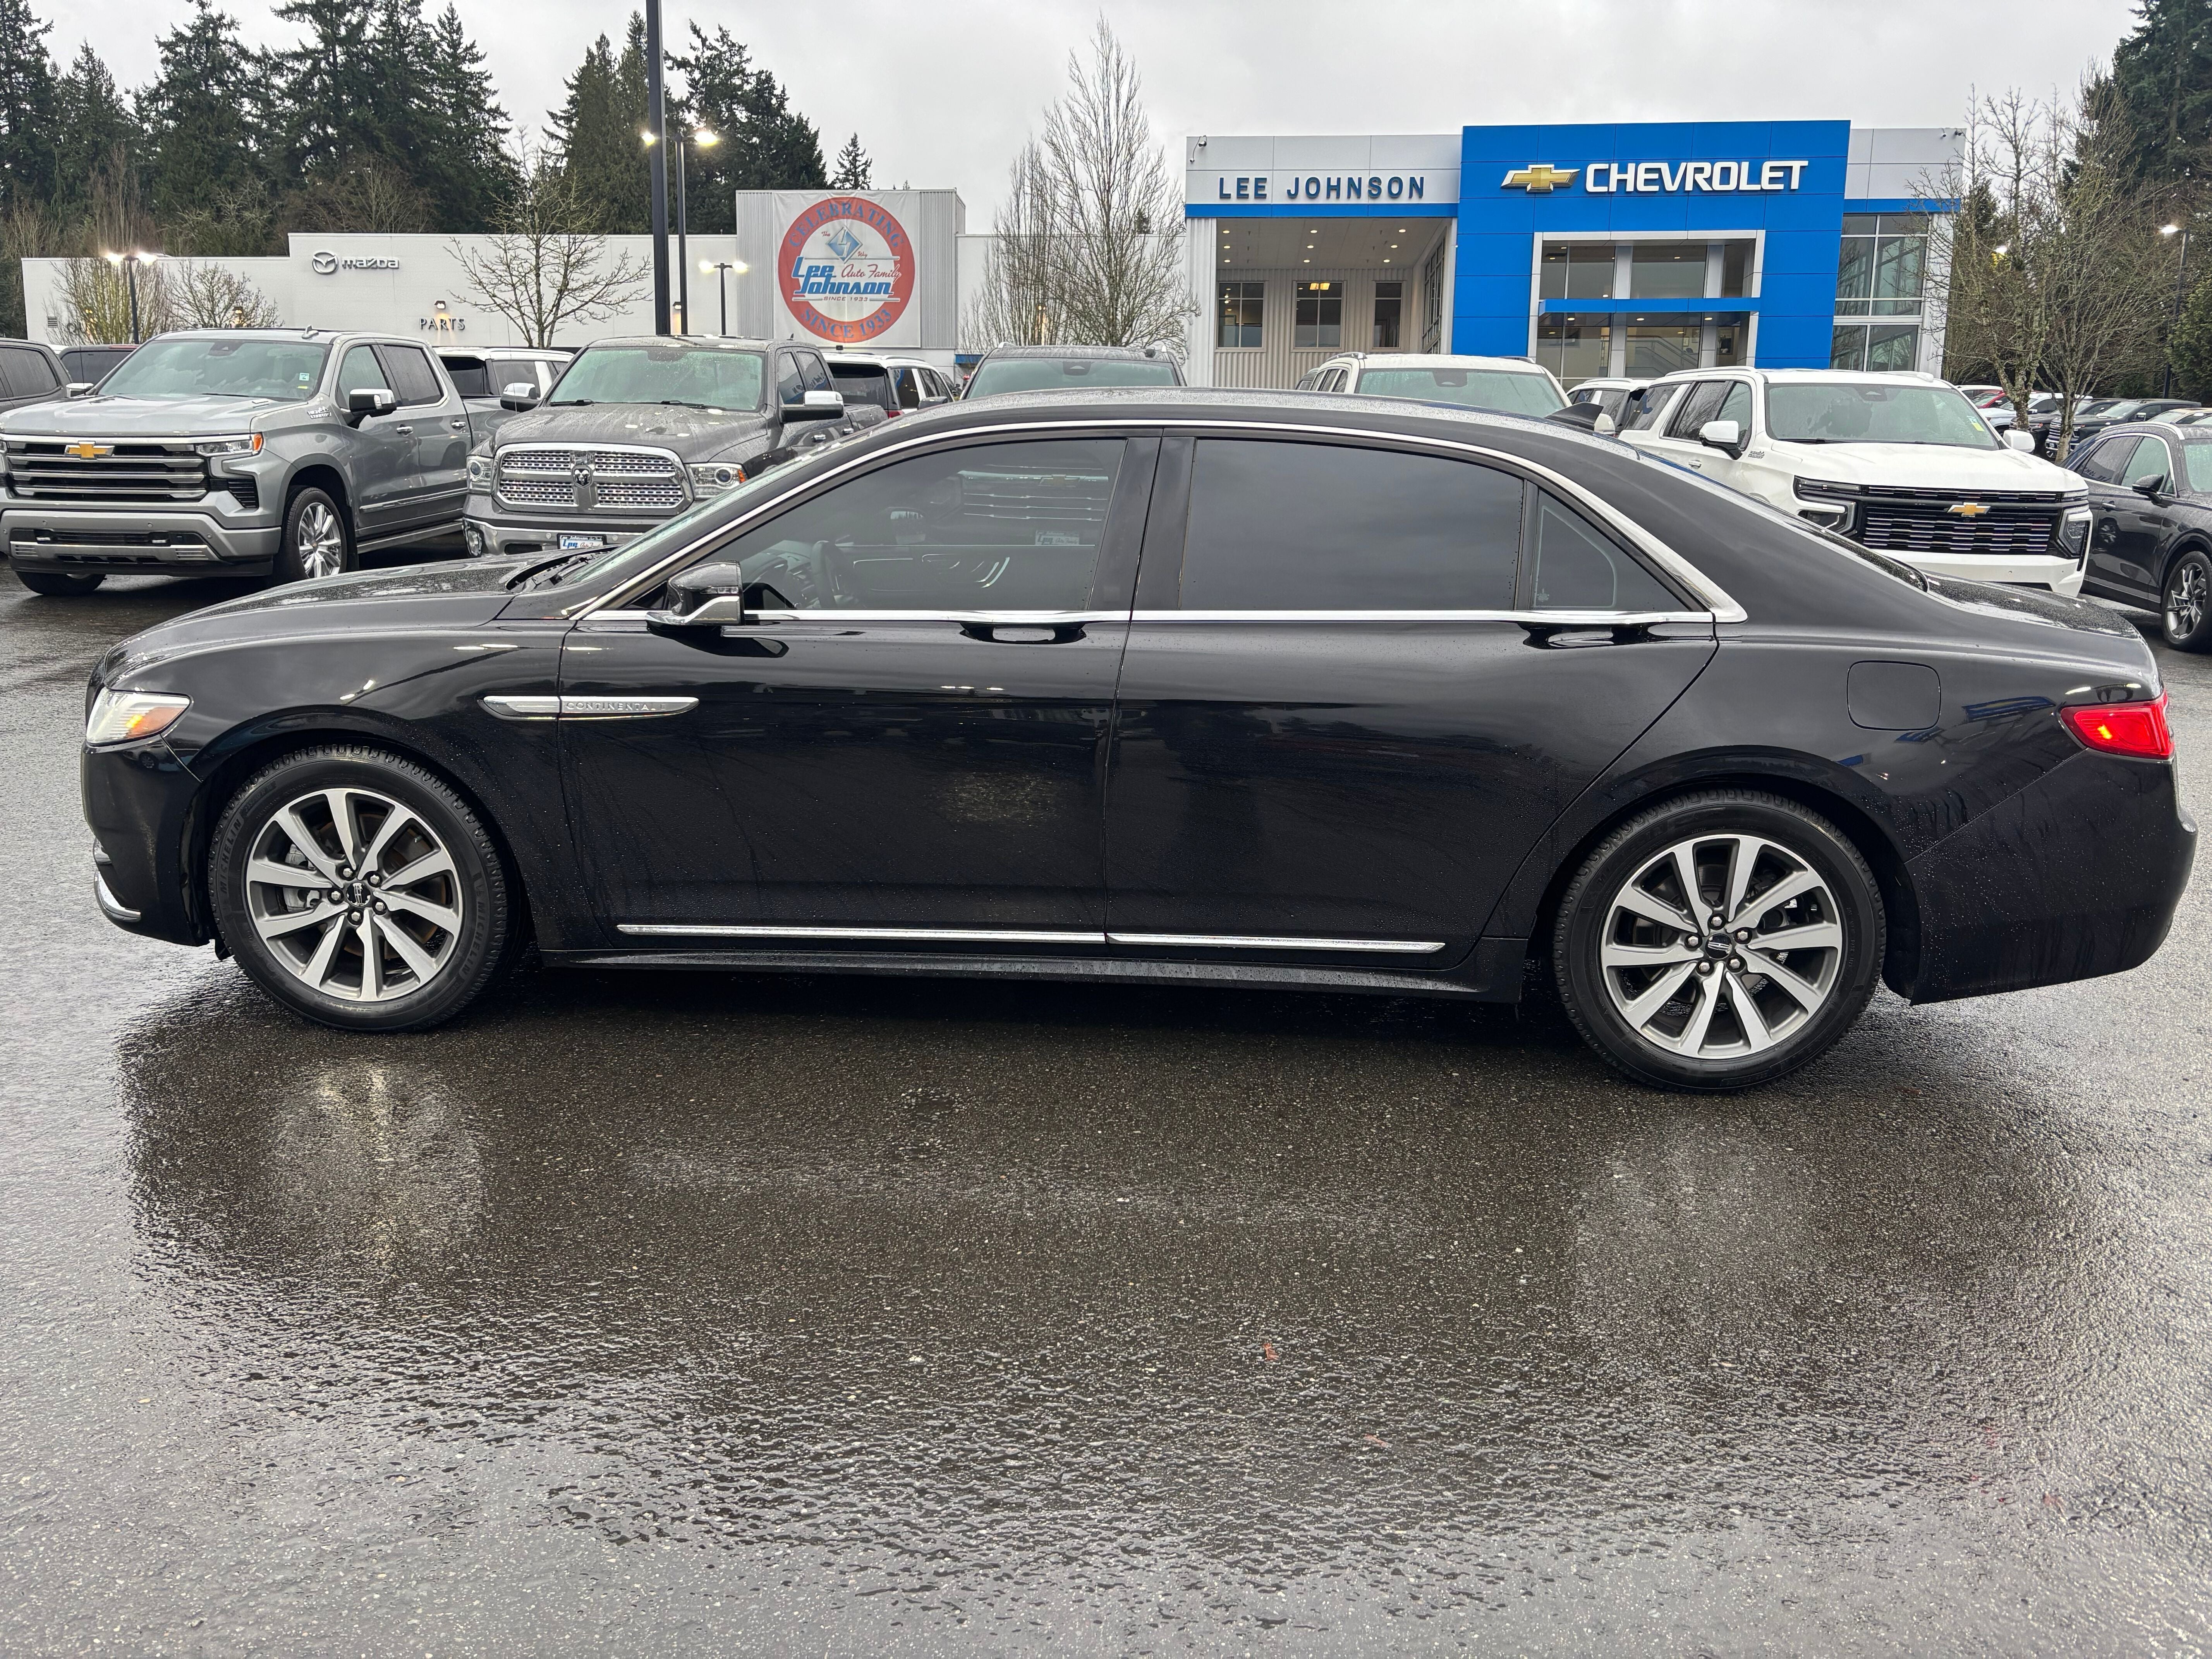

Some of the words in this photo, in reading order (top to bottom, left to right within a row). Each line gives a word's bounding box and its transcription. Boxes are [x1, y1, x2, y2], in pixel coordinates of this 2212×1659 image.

[1219, 177, 1268, 199] LEE
[1286, 176, 1425, 199] JOHNSON
[1585, 160, 1808, 192] CHEVROLET
[789, 202, 905, 247] CELEBRATING
[342, 257, 399, 269] mazda
[792, 256, 836, 278] Lee
[841, 264, 866, 278] Auto
[867, 264, 902, 284] Family
[794, 271, 894, 295] Johnson
[419, 318, 465, 330] PARTS
[800, 308, 854, 338] SINCE
[859, 309, 891, 337] 1933
[566, 702, 657, 711] CONTINENTAL
[220, 819, 241, 895] MICHELIN
[461, 901, 486, 975] MICHELIN
